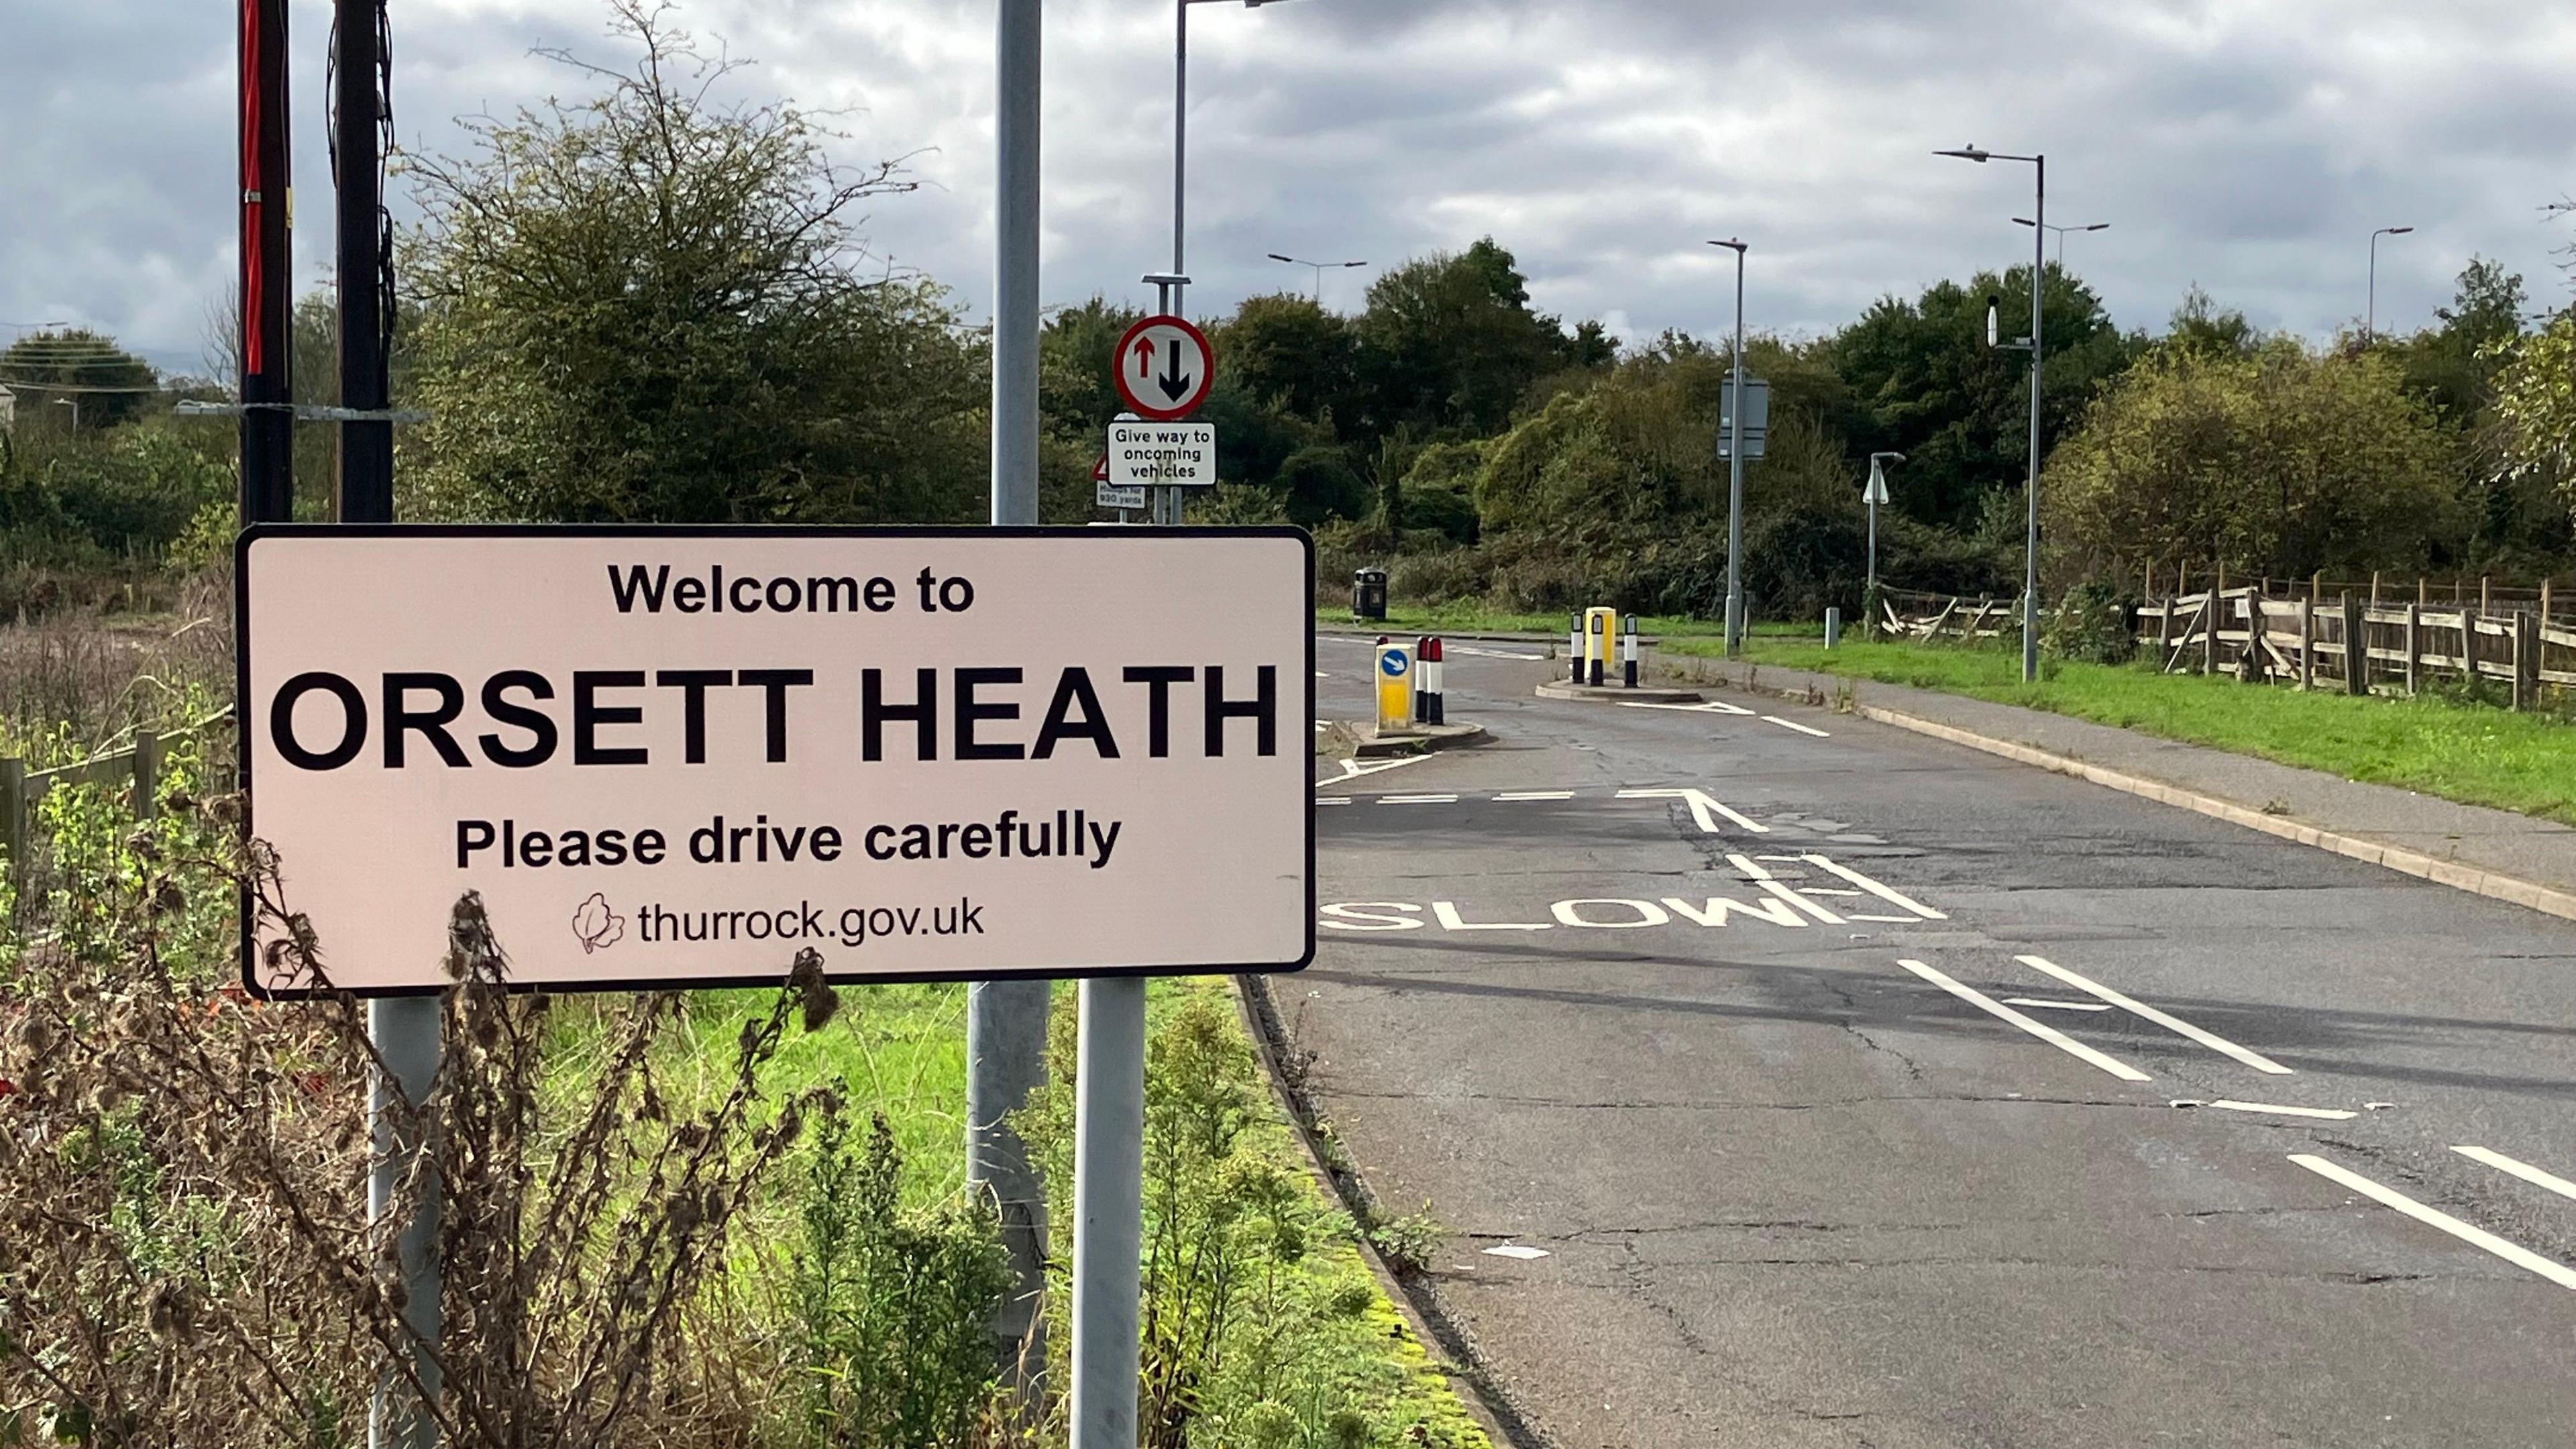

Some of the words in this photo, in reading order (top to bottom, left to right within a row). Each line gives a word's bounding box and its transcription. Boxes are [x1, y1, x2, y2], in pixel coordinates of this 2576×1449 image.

[1116, 429, 1150, 443] Give
[1157, 432, 1189, 445] way
[1193, 429, 1210, 443] to
[1124, 447, 1201, 462] oncoming
[1131, 464, 1195, 478] vehicles
[608, 565, 896, 613] Welcome
[916, 566, 974, 612] to
[270, 669, 814, 771] ORSETT
[862, 665, 1277, 762] HEATH
[458, 819, 666, 869] Please
[689, 815, 842, 864] drive
[865, 809, 1122, 869] carefully
[637, 896, 984, 947] thurrock.gov.uk
[1318, 898, 1809, 931] SLOW
